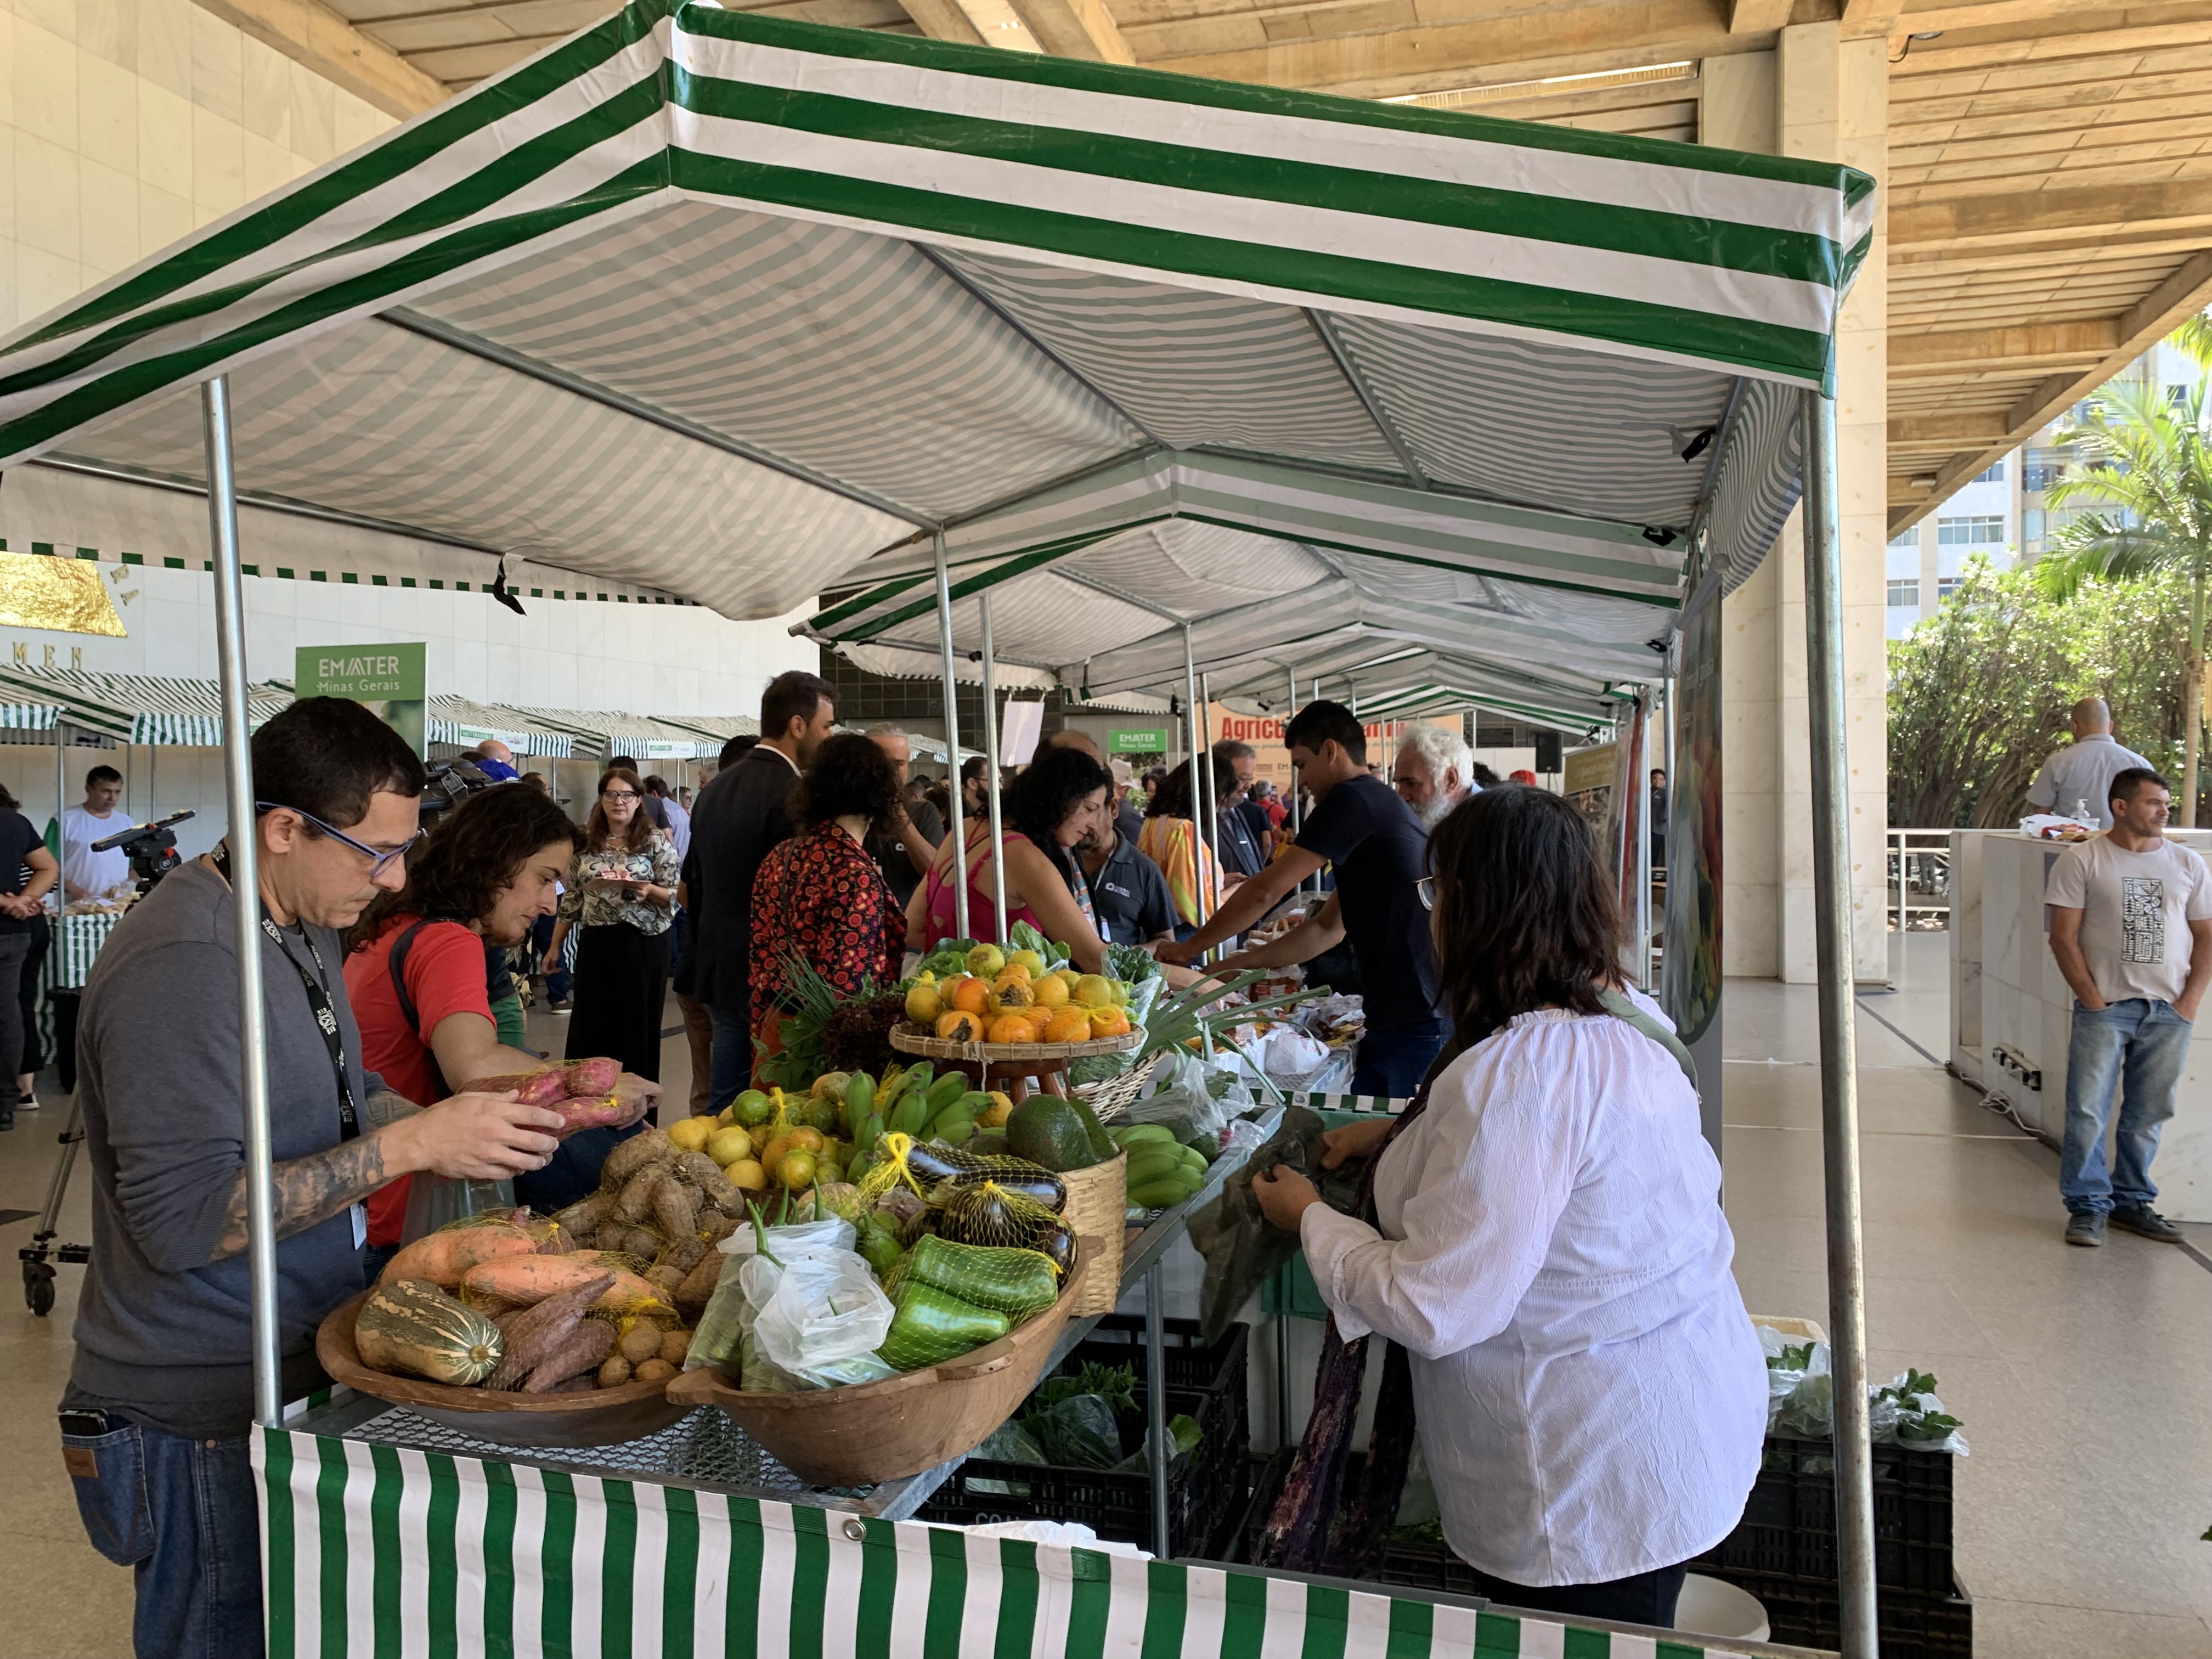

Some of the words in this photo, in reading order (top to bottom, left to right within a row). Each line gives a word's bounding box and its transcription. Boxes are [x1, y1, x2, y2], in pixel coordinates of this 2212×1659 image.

[319, 656, 400, 678] EMATER
[317, 681, 353, 693] Minas
[359, 678, 400, 691] Gerais
[1221, 716, 1285, 741] Agricu
